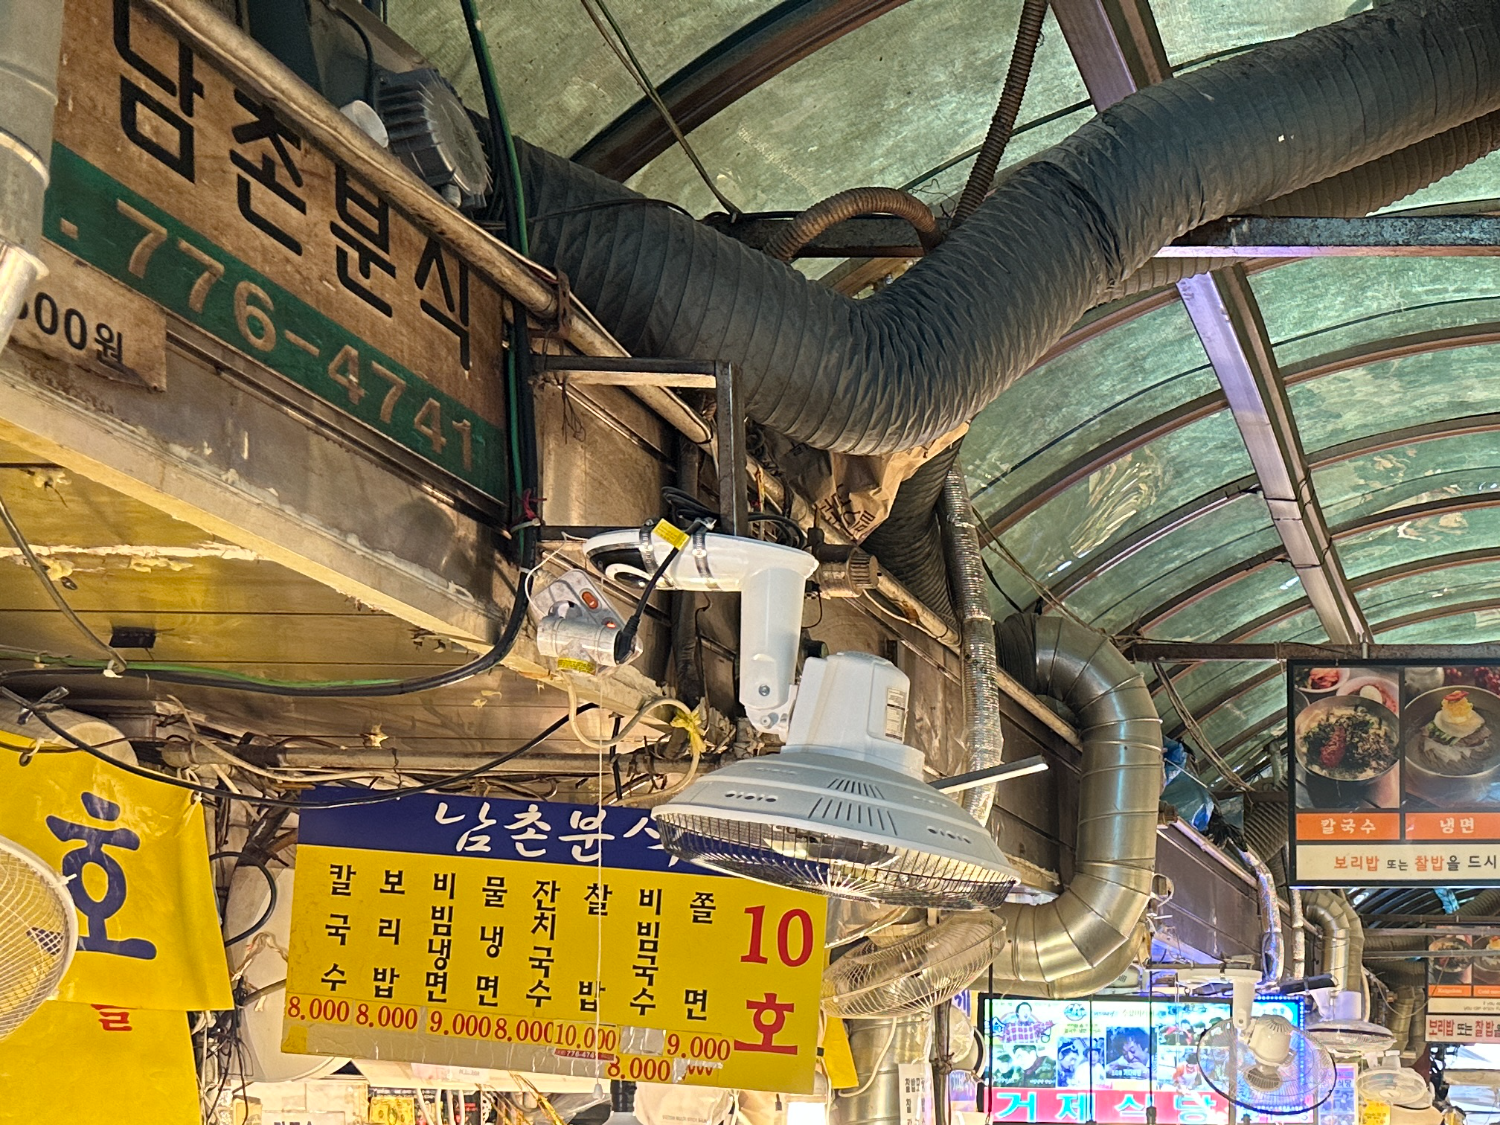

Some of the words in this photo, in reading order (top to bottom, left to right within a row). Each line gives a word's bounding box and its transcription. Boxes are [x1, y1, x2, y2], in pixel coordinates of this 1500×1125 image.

[1320, 817, 1377, 835] 칼국수
[1438, 817, 1475, 834] 냉면
[1334, 854, 1380, 872] 보리밥
[1386, 857, 1408, 871] 또는
[1414, 854, 1461, 872] 찰밥을
[320, 865, 356, 993] 칼국수
[373, 869, 406, 999] 보리밥
[424, 872, 457, 1004] 비빔냉면
[476, 876, 508, 1008] 물냉면
[525, 880, 561, 1009] 잔치국수
[577, 882, 612, 1013] 찰밥
[630, 887, 663, 1018] 비빔국수
[684, 890, 717, 1022] 쫄면
[739, 903, 815, 968] 10
[286, 997, 350, 1024] 8.000
[355, 1002, 418, 1031] 8.000
[428, 1009, 491, 1039] 9.000
[666, 1035, 731, 1062] 9.000
[734, 992, 799, 1056] 호
[1429, 1019, 1454, 1037] 보리밥
[1457, 1022, 1473, 1037] 또는
[607, 1054, 671, 1083] 8.000
[995, 1091, 1217, 1125] 거제식당
